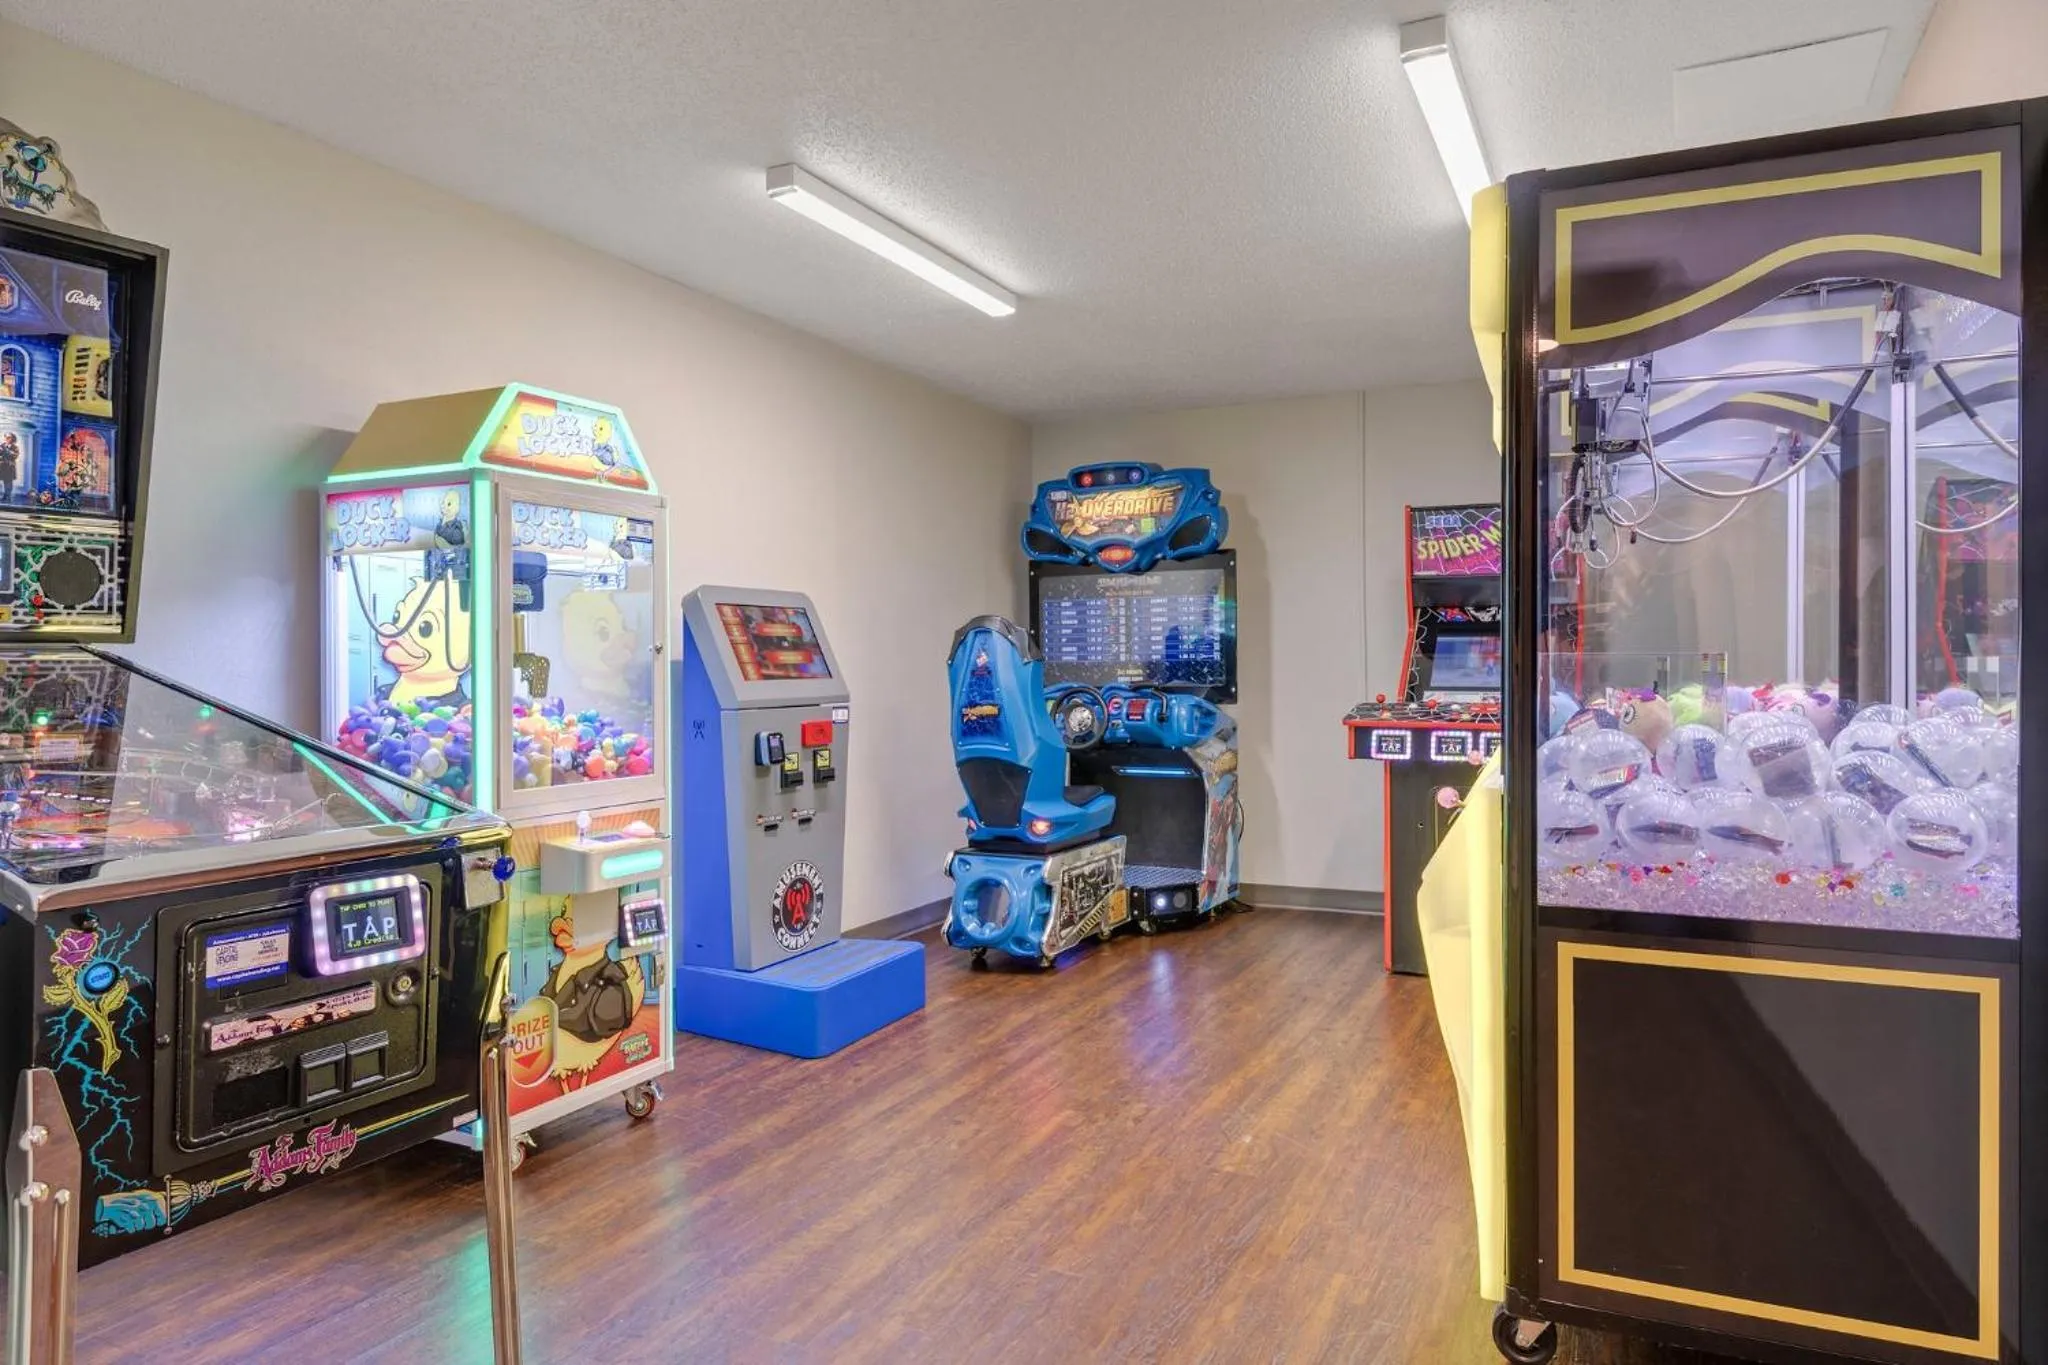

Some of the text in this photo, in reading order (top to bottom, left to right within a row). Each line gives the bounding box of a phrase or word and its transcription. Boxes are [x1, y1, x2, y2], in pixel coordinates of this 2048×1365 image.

[65, 289, 102, 311] Bally
[520, 412, 580, 437] DUCK
[517, 435, 594, 458] LOCKER
[337, 495, 396, 526] DUCK
[512, 502, 574, 527] DUCK
[1425, 515, 1462, 529] SEGA
[328, 517, 410, 552] LOCKER
[773, 862, 824, 908] AMUSEMENT
[777, 914, 820, 949] CONNECT
[512, 1032, 545, 1055] OUT
